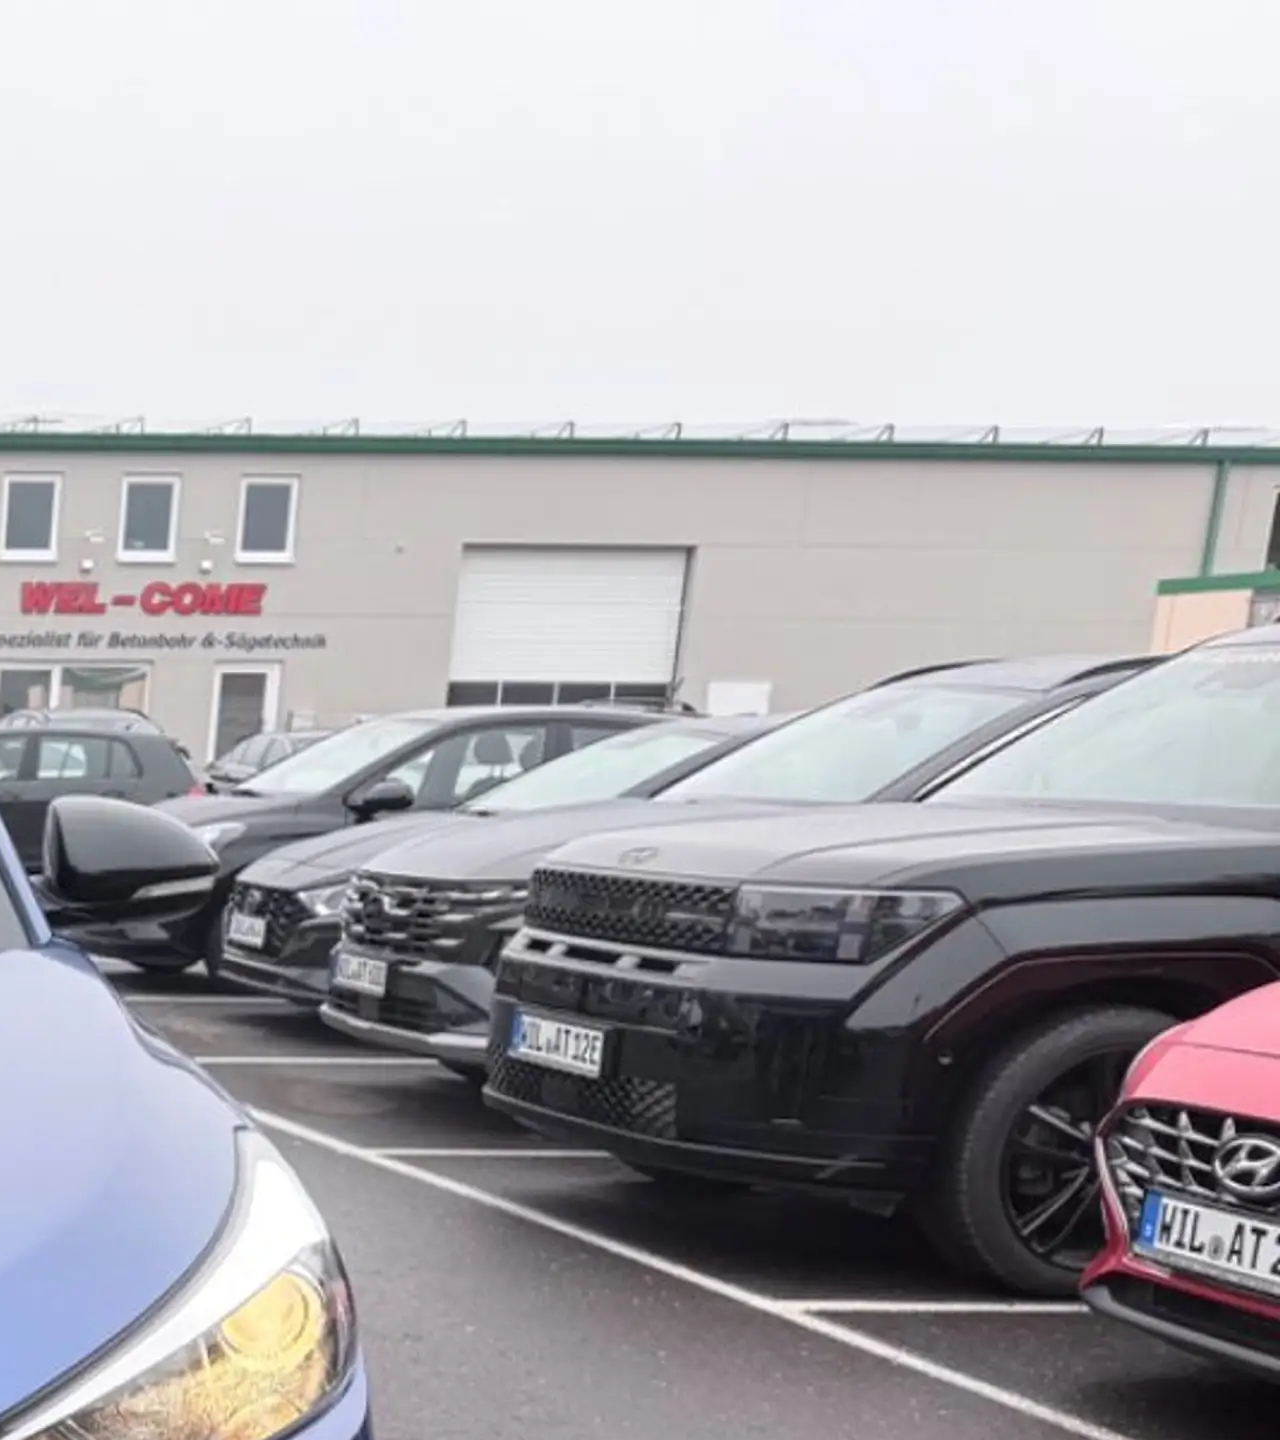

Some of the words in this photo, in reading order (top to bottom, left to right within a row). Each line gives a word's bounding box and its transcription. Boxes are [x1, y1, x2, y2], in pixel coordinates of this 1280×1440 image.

[76, 631, 104, 648] für
[107, 632, 197, 648] Betonbohr
[1160, 1202, 1205, 1254] WIL
